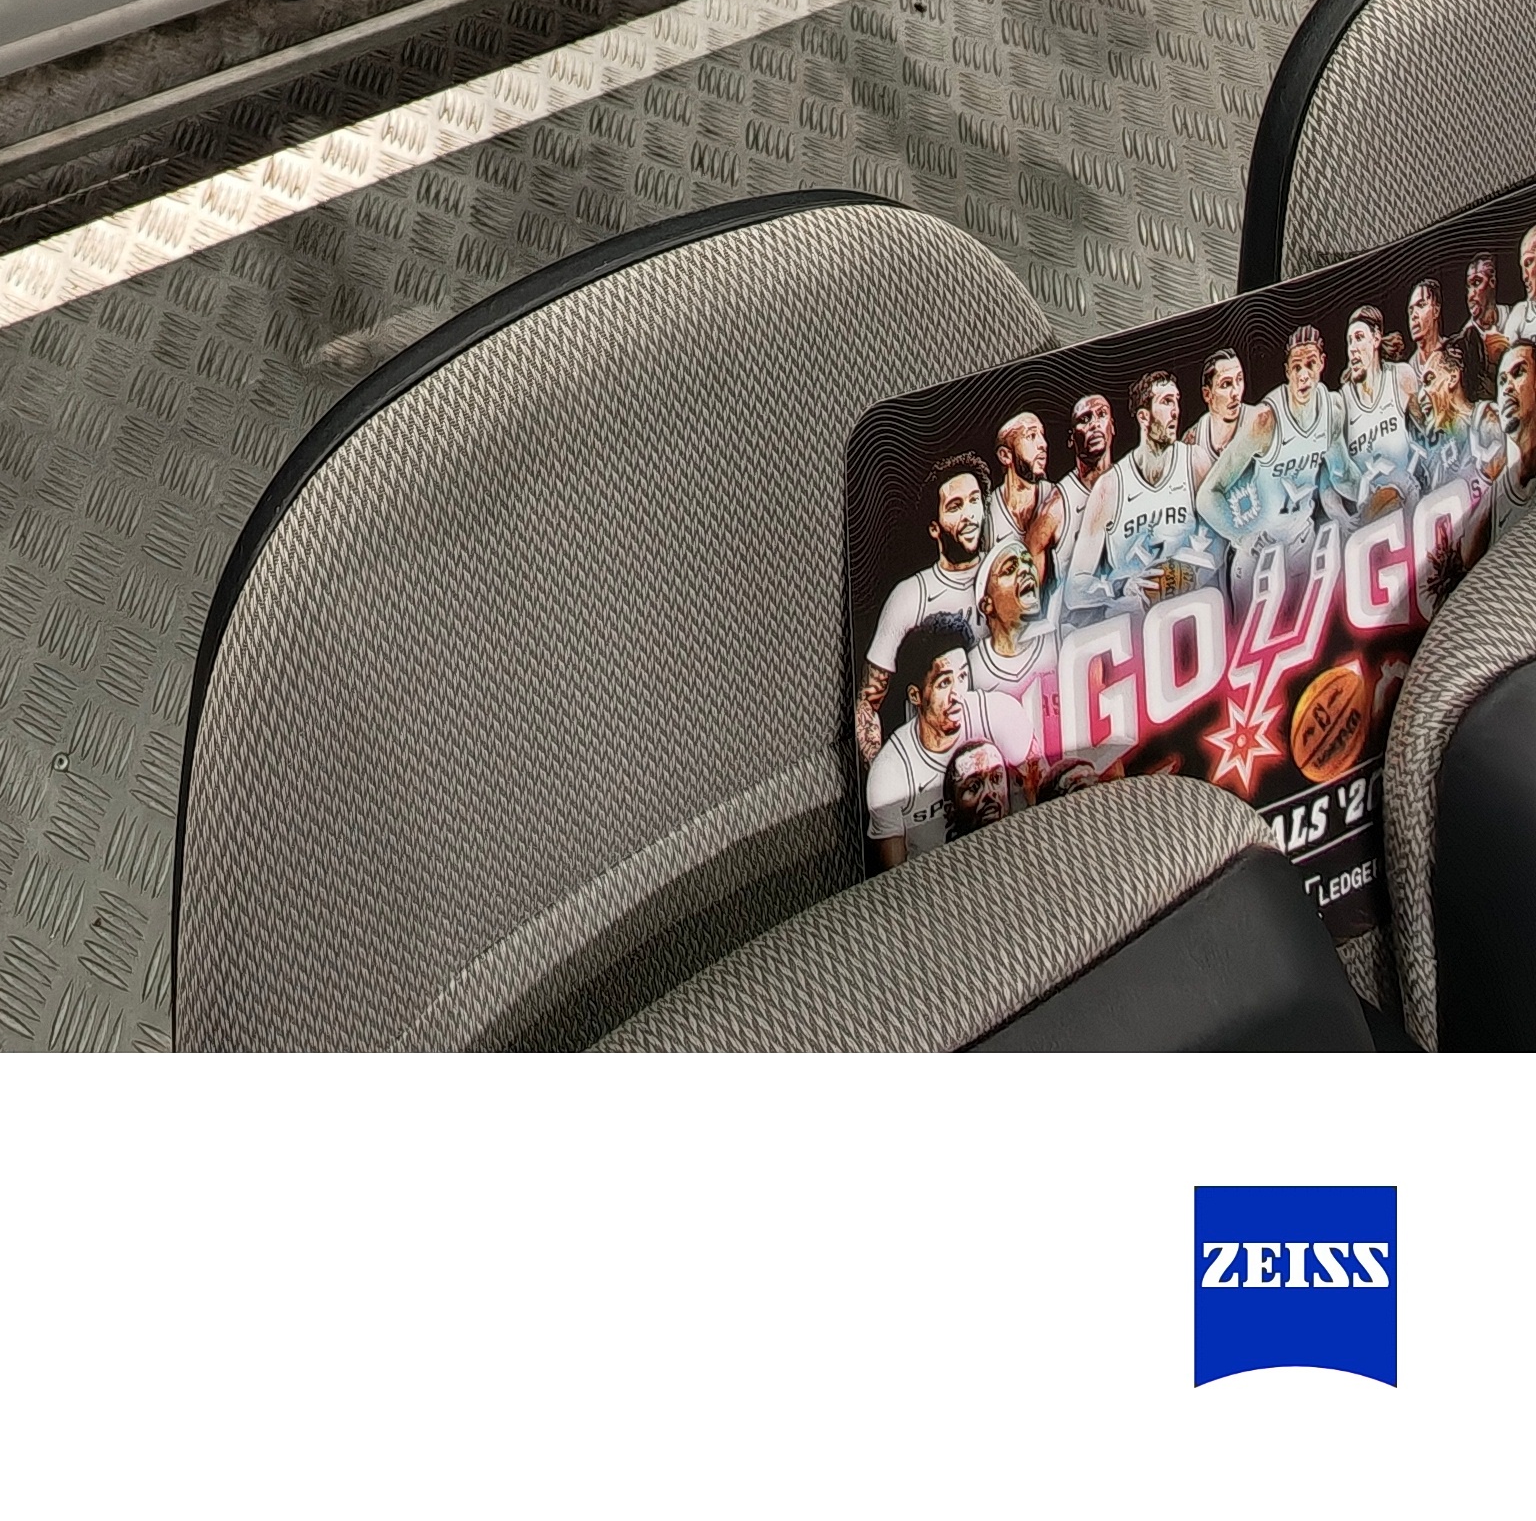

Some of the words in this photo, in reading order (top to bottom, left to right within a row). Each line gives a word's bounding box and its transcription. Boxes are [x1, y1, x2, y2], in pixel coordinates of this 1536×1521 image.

[1124, 506, 1187, 539] SPURS
[1062, 585, 1227, 767] GO
[1271, 794, 1332, 855] ALS
